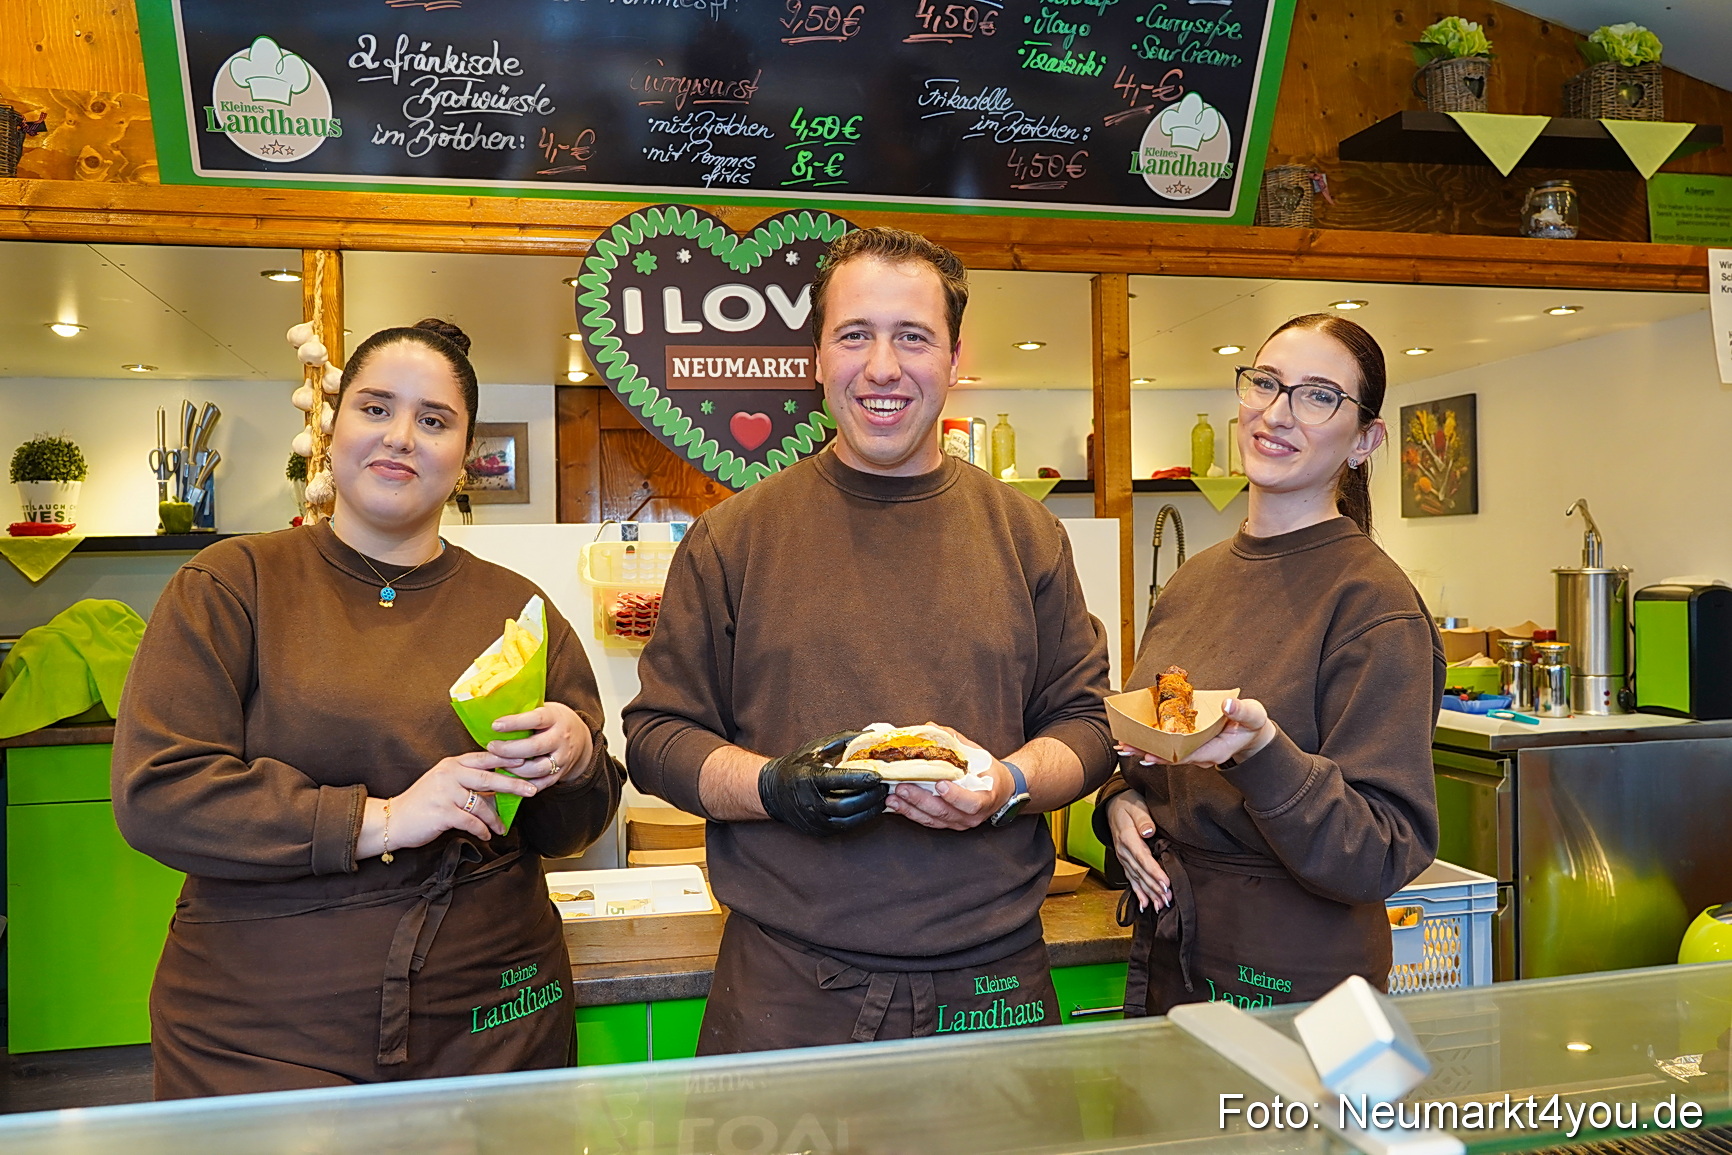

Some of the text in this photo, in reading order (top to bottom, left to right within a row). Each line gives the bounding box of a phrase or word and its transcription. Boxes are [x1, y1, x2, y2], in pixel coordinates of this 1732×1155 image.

[349, 33, 524, 85] 2 fränkische
[1137, 34, 1182, 63] Sour
[402, 75, 557, 121] Bratwürste
[630, 58, 762, 111] Currywurst
[918, 78, 1015, 112] Frikadelle
[220, 100, 265, 114] Kleines
[203, 106, 343, 138] Landhaus
[371, 123, 405, 147] im
[650, 112, 694, 135] mit
[789, 107, 864, 140] 4,50€
[969, 115, 1000, 131] im
[646, 139, 757, 169] mit Pommes
[1006, 148, 1089, 181] 4,50€
[1128, 151, 1234, 179] Landhaus
[1144, 147, 1178, 158] Kleines
[622, 283, 813, 335] I LOV
[672, 356, 810, 379] NEUMARKT
[500, 962, 538, 989] Kleines
[973, 975, 1020, 995] Kleines
[1237, 964, 1293, 993] Kleines
[470, 979, 564, 1034] Landhaus
[935, 998, 1045, 1033] Landhaus
